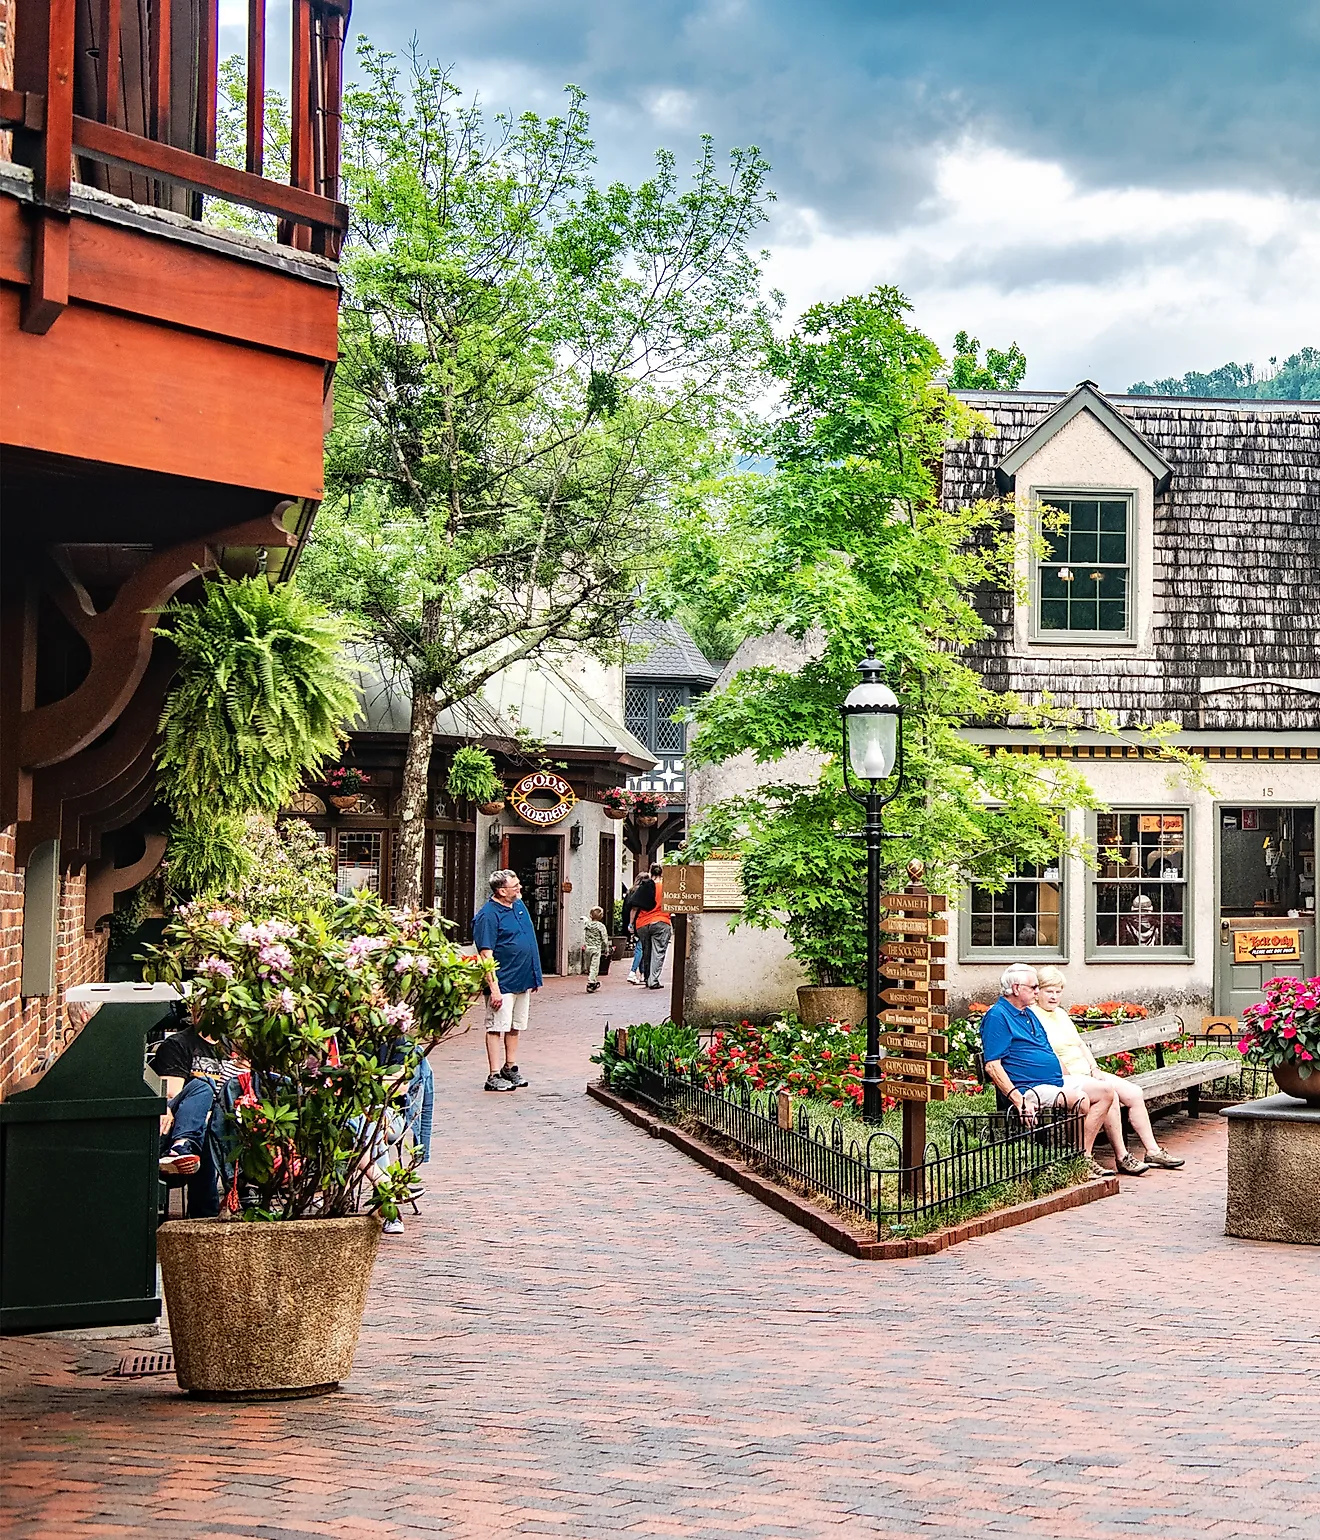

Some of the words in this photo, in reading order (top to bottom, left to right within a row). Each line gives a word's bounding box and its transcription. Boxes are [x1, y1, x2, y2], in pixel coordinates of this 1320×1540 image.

[1262, 788, 1273, 796] 15
[519, 802, 570, 822] CORNER
[680, 882, 686, 891] 8
[682, 892, 702, 900] SHOPS
[889, 898, 896, 906] U
[896, 898, 919, 908] NAME
[920, 900, 928, 909] IT
[888, 944, 898, 955] THE
[886, 1084, 927, 1098] RESTROOMS
